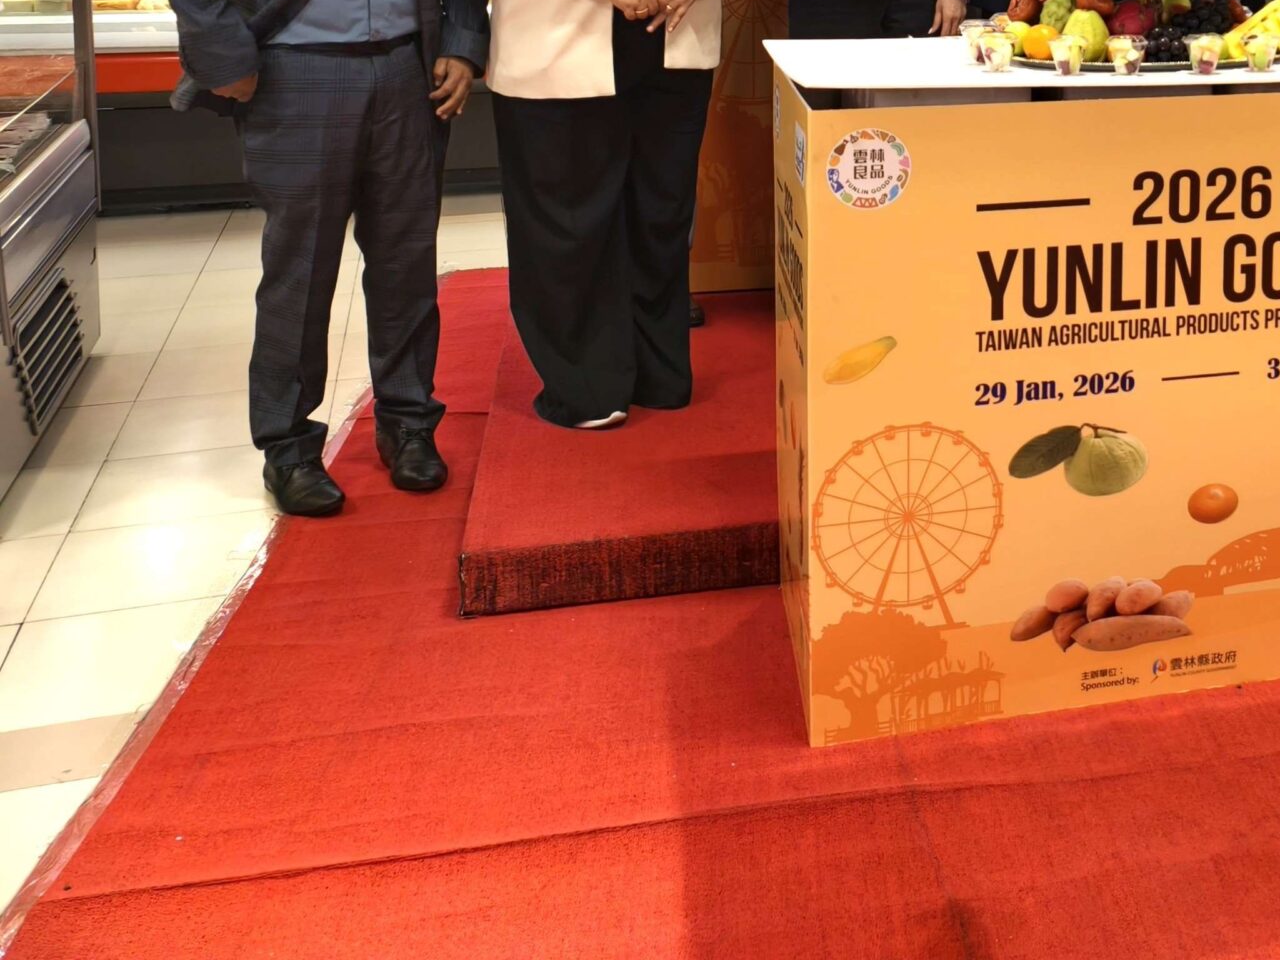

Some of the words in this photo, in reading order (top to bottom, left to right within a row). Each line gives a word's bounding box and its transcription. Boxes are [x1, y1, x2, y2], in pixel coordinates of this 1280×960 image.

[853, 148, 885, 164] 雲林
[853, 165, 885, 180] 良品
[845, 179, 869, 195] YUNLIN
[871, 175, 894, 194] GOODS
[1132, 165, 1272, 225] 2026
[976, 237, 1202, 321] YUNLIN
[975, 326, 1043, 353] TAIWAN
[1047, 317, 1171, 347] AGRICULTURAL
[1176, 309, 1260, 337] PRODUCTS
[974, 381, 1007, 406] 29
[1013, 379, 1064, 406] Jan,
[1073, 370, 1136, 397] 2026
[1170, 650, 1237, 671] 雲林縣政府
[1081, 678, 1125, 692] Sponsored
[1127, 676, 1140, 688] by:
